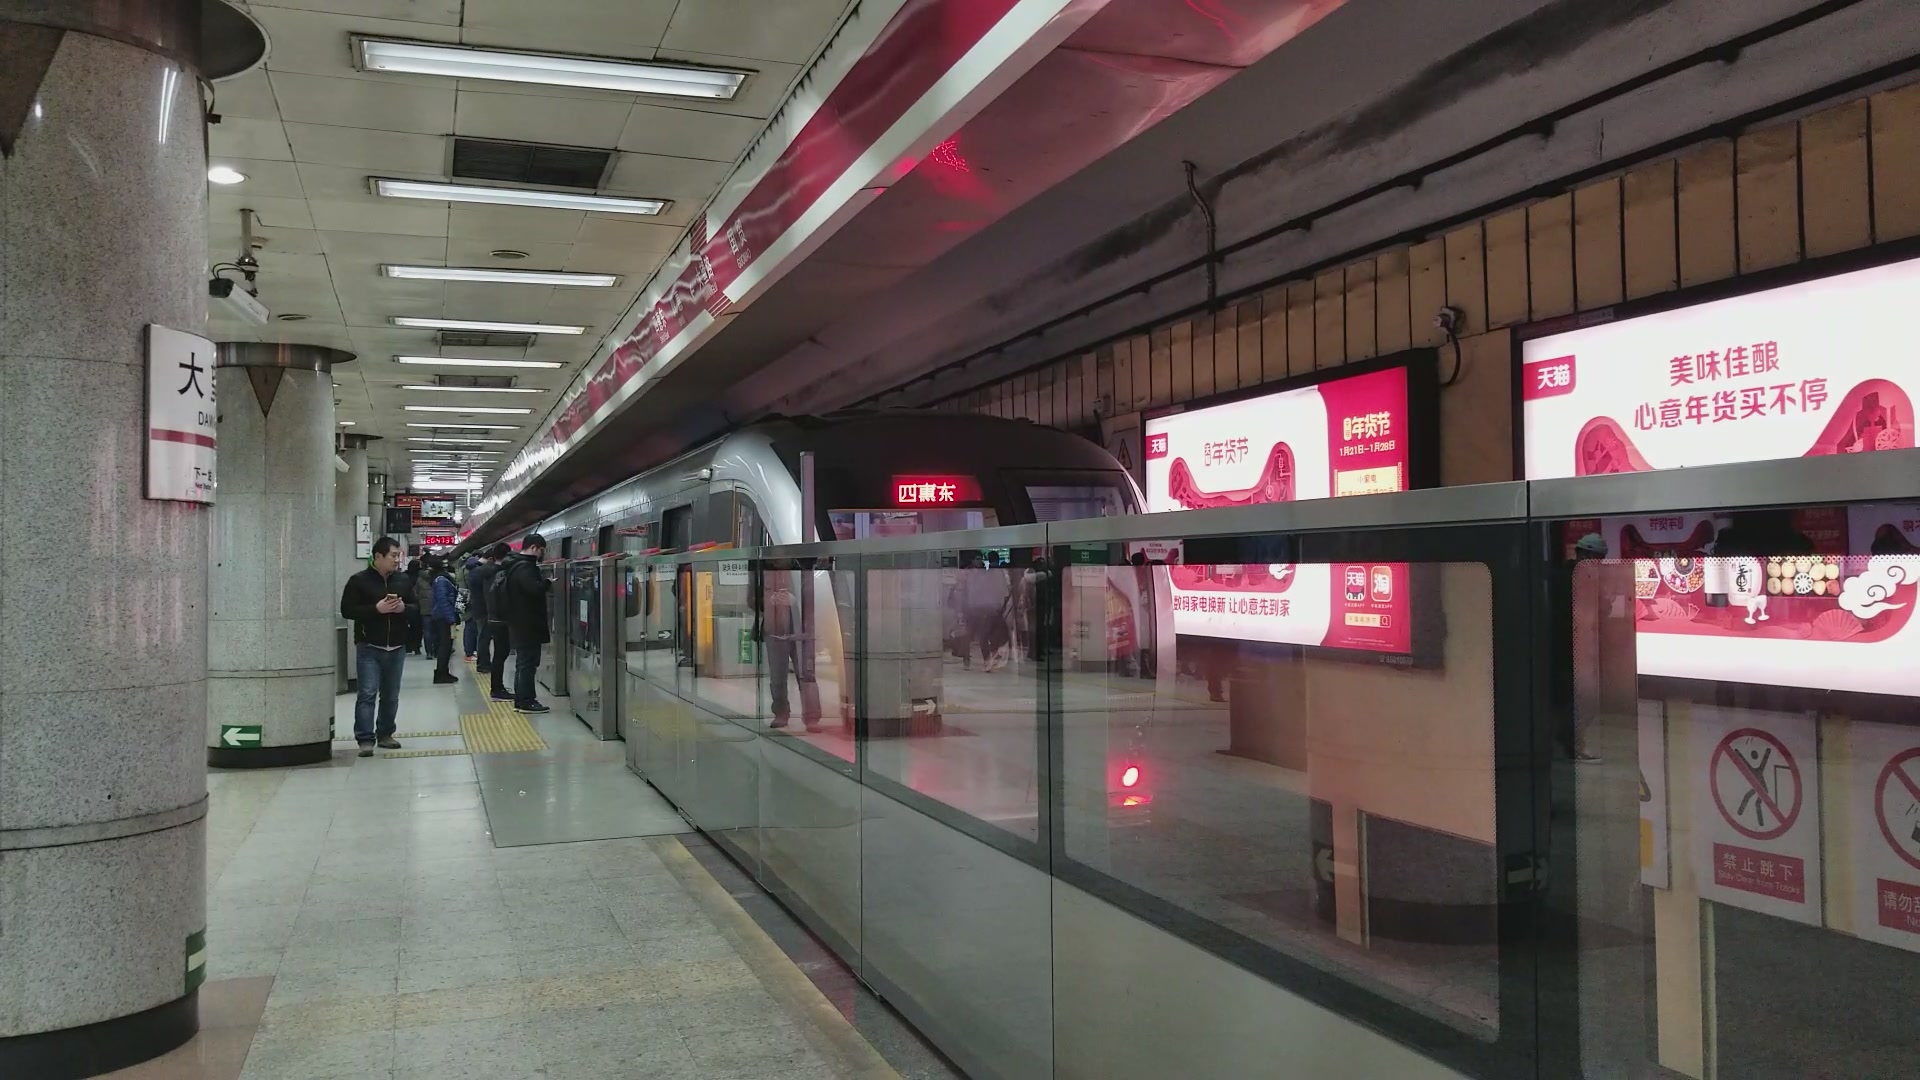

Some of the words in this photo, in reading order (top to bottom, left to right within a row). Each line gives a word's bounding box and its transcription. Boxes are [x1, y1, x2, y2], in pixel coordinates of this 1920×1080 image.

[1537, 363, 1571, 390] 天猫
[1669, 340, 1780, 387] 美味佳酿
[1634, 377, 1829, 431] 心意年货买不停
[1351, 410, 1391, 440] 年货节
[1151, 437, 1167, 454] 天猫
[1212, 436, 1249, 465] 年货节
[898, 482, 957, 503] 四惠东
[1347, 572, 1364, 586] 天猫
[1374, 573, 1390, 595] 淘
[1173, 596, 1226, 613] 数码家电换新
[1228, 597, 1290, 617] 让心意先到家
[1723, 852, 1793, 881] 禁止跳下
